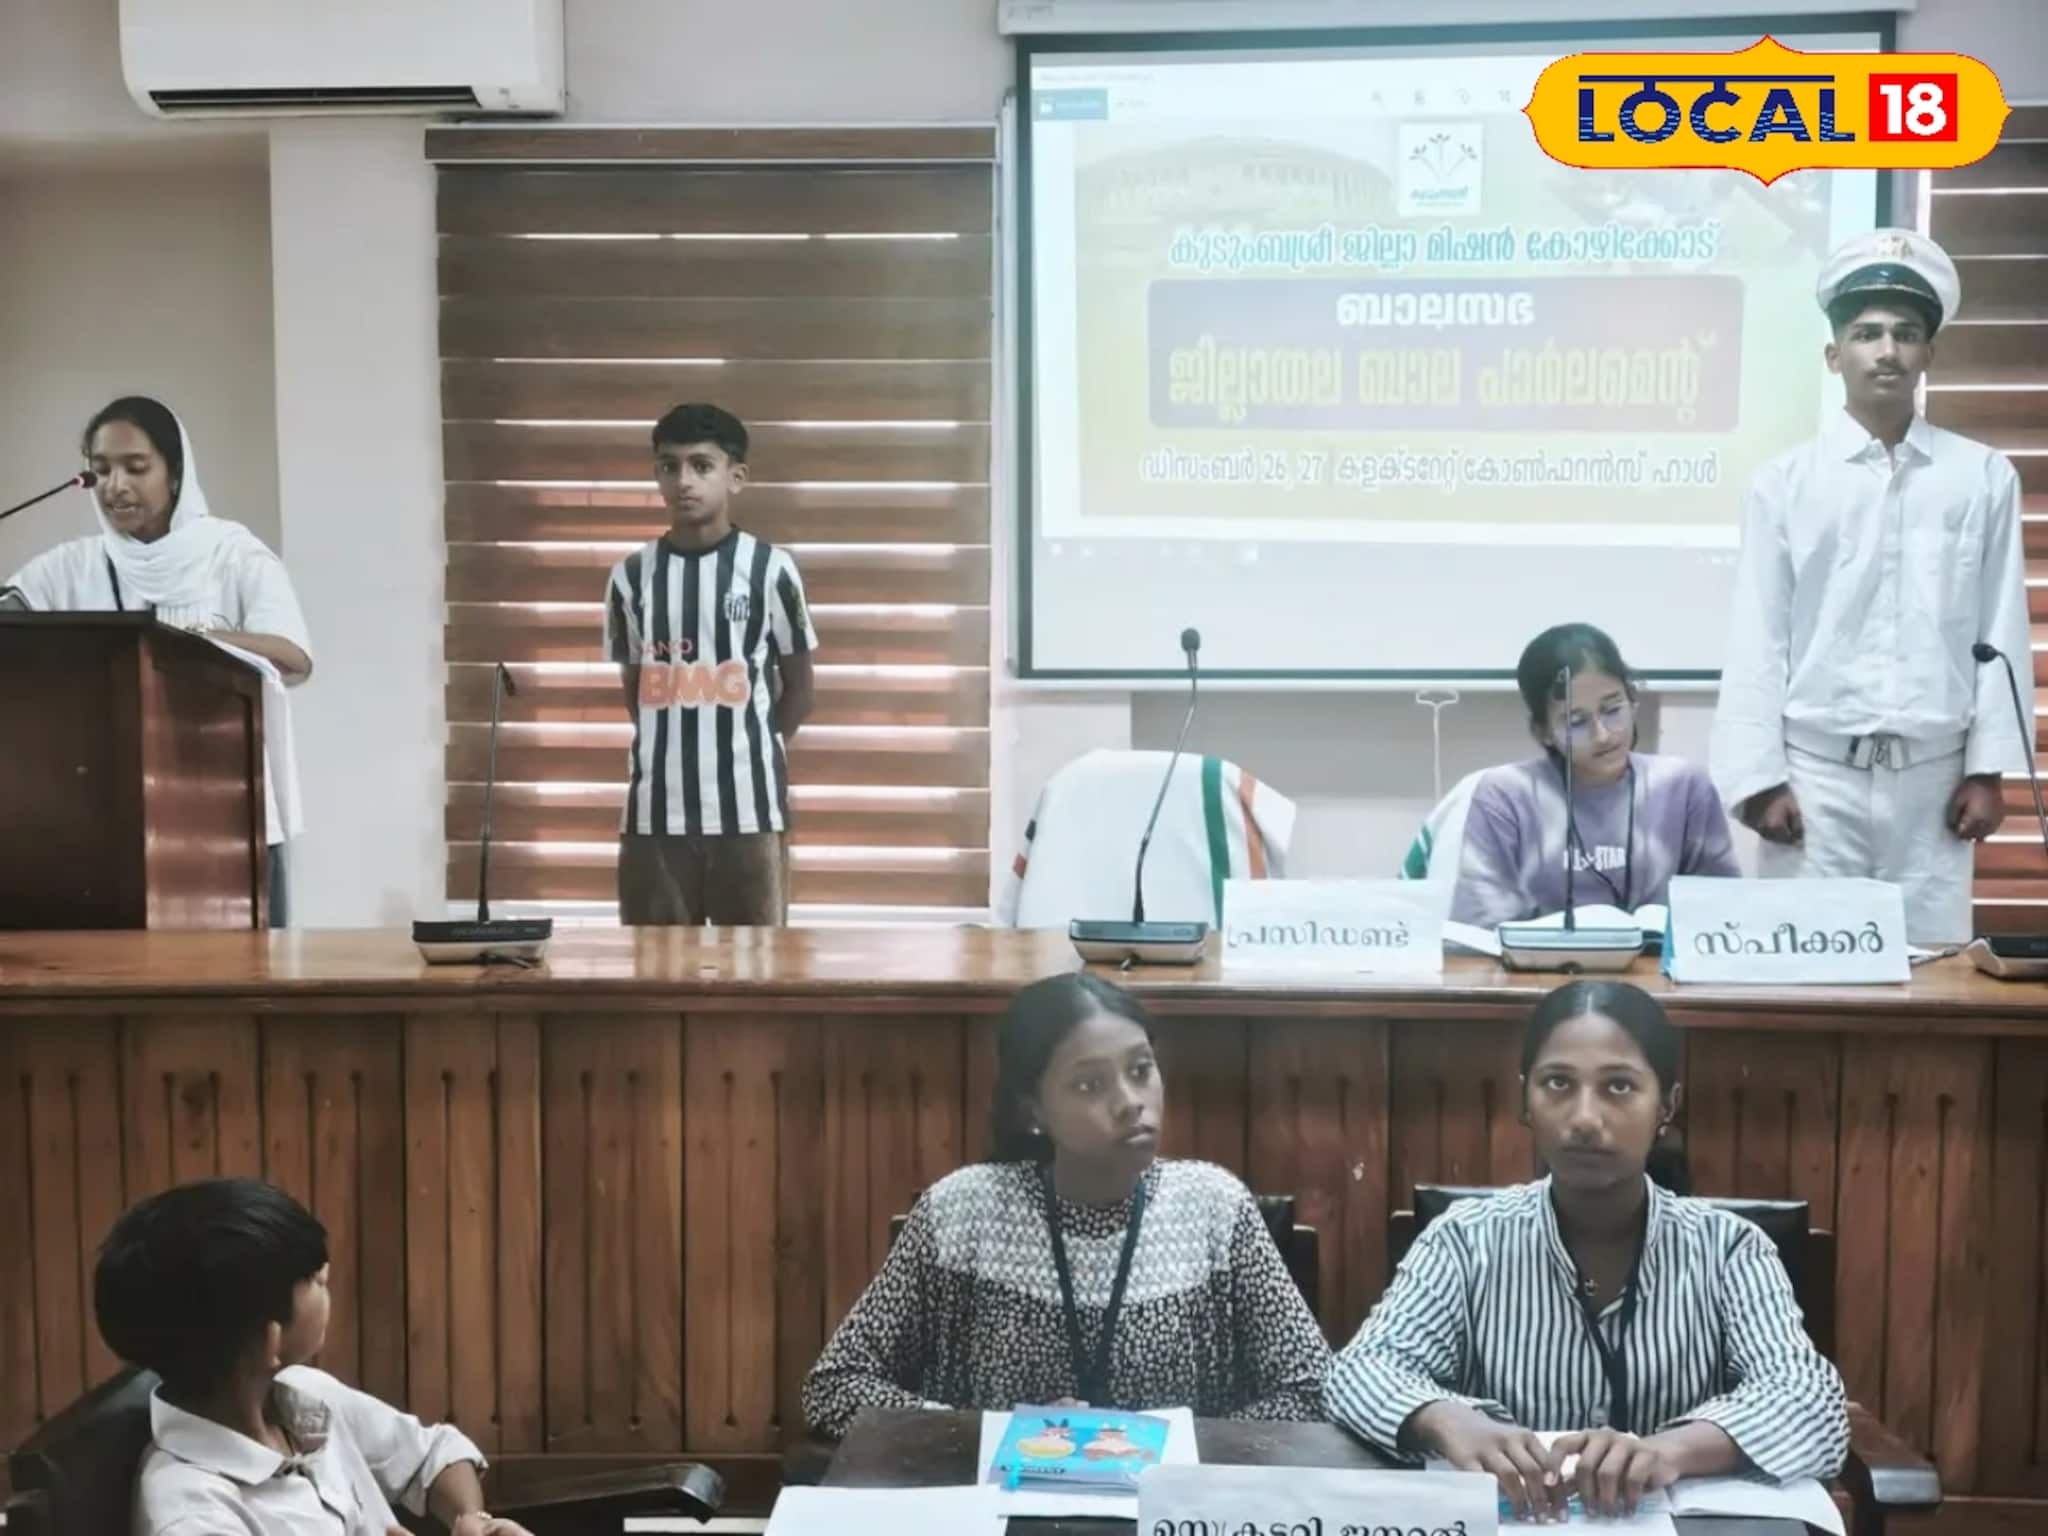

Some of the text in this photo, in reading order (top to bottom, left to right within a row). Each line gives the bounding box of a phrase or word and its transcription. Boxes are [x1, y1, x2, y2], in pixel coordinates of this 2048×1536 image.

[1170, 223, 1720, 271] കുടുംബശ്രീ ജില്ലാ മിഷൻ കോഴിക്കോട്
[1168, 334, 1343, 424] ജില്ലാതല
[1358, 347, 1461, 406] ബാല
[1140, 445, 1257, 483] ഡിസംബർ
[1651, 449, 1719, 486] ഹാൾ
[640, 660, 750, 707] BMG
[1693, 920, 1885, 955] സ്പീക്കർ
